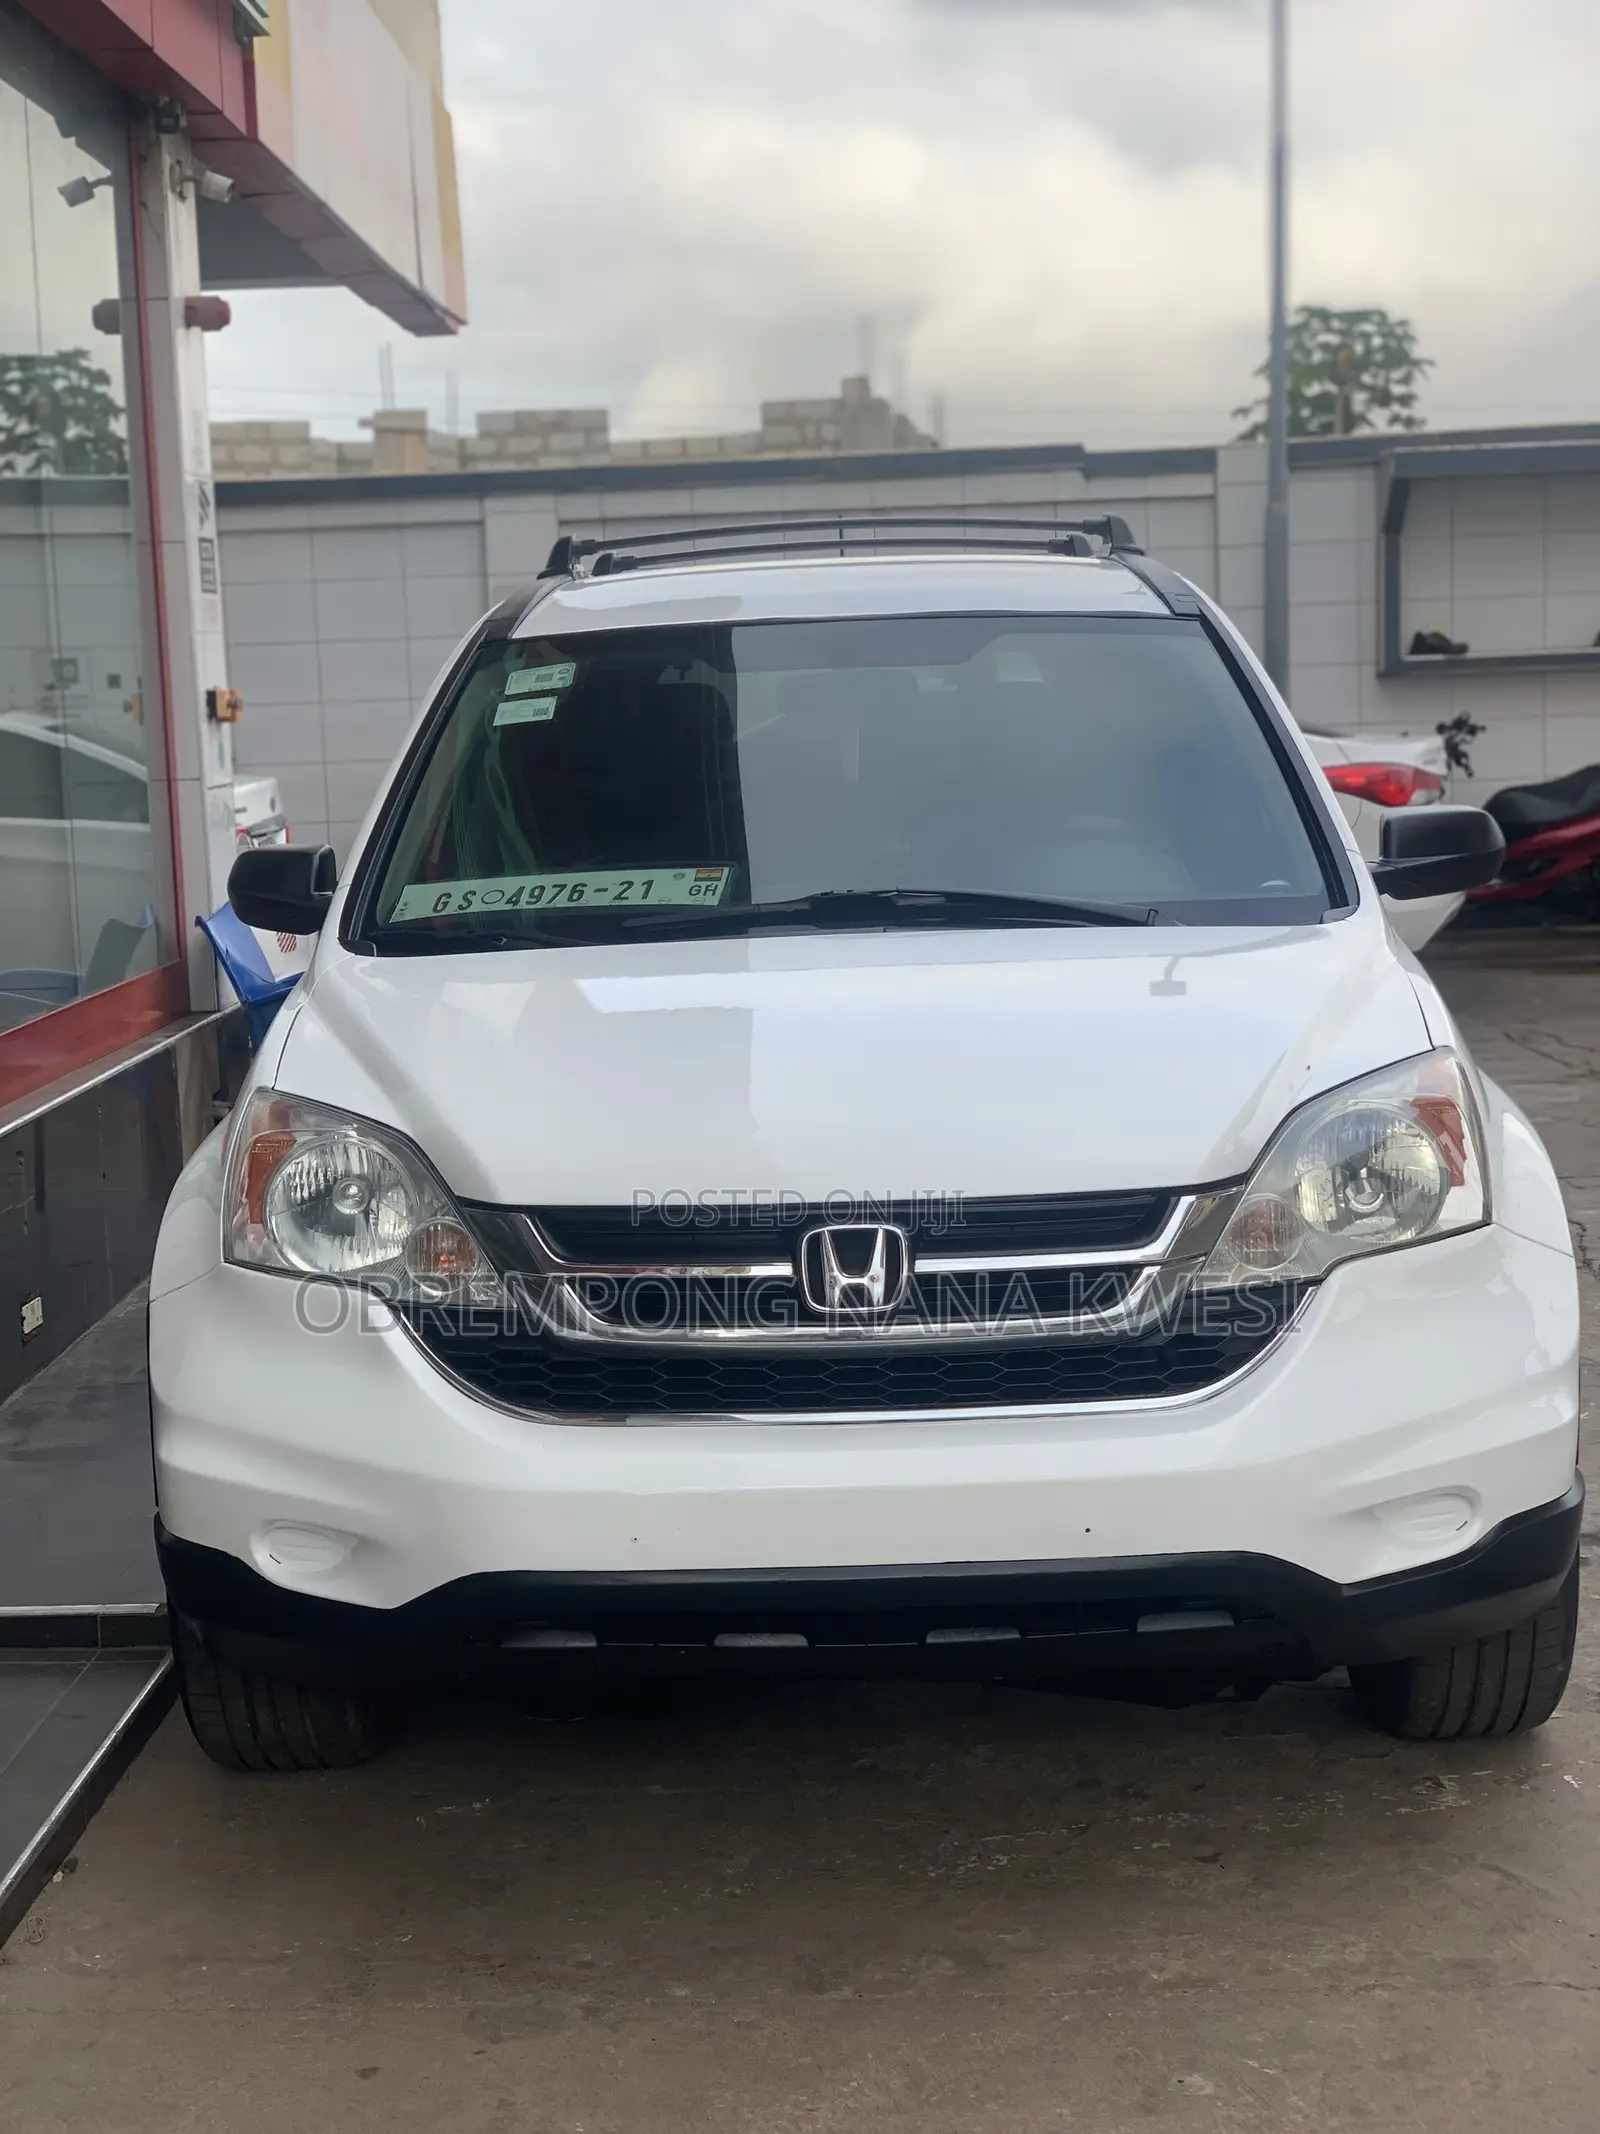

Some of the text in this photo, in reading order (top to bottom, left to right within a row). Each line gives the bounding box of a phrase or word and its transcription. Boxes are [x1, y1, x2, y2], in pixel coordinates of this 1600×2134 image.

[433, 890, 477, 913] GS
[505, 879, 655, 907] 4976-21
[688, 883, 719, 897] GH
